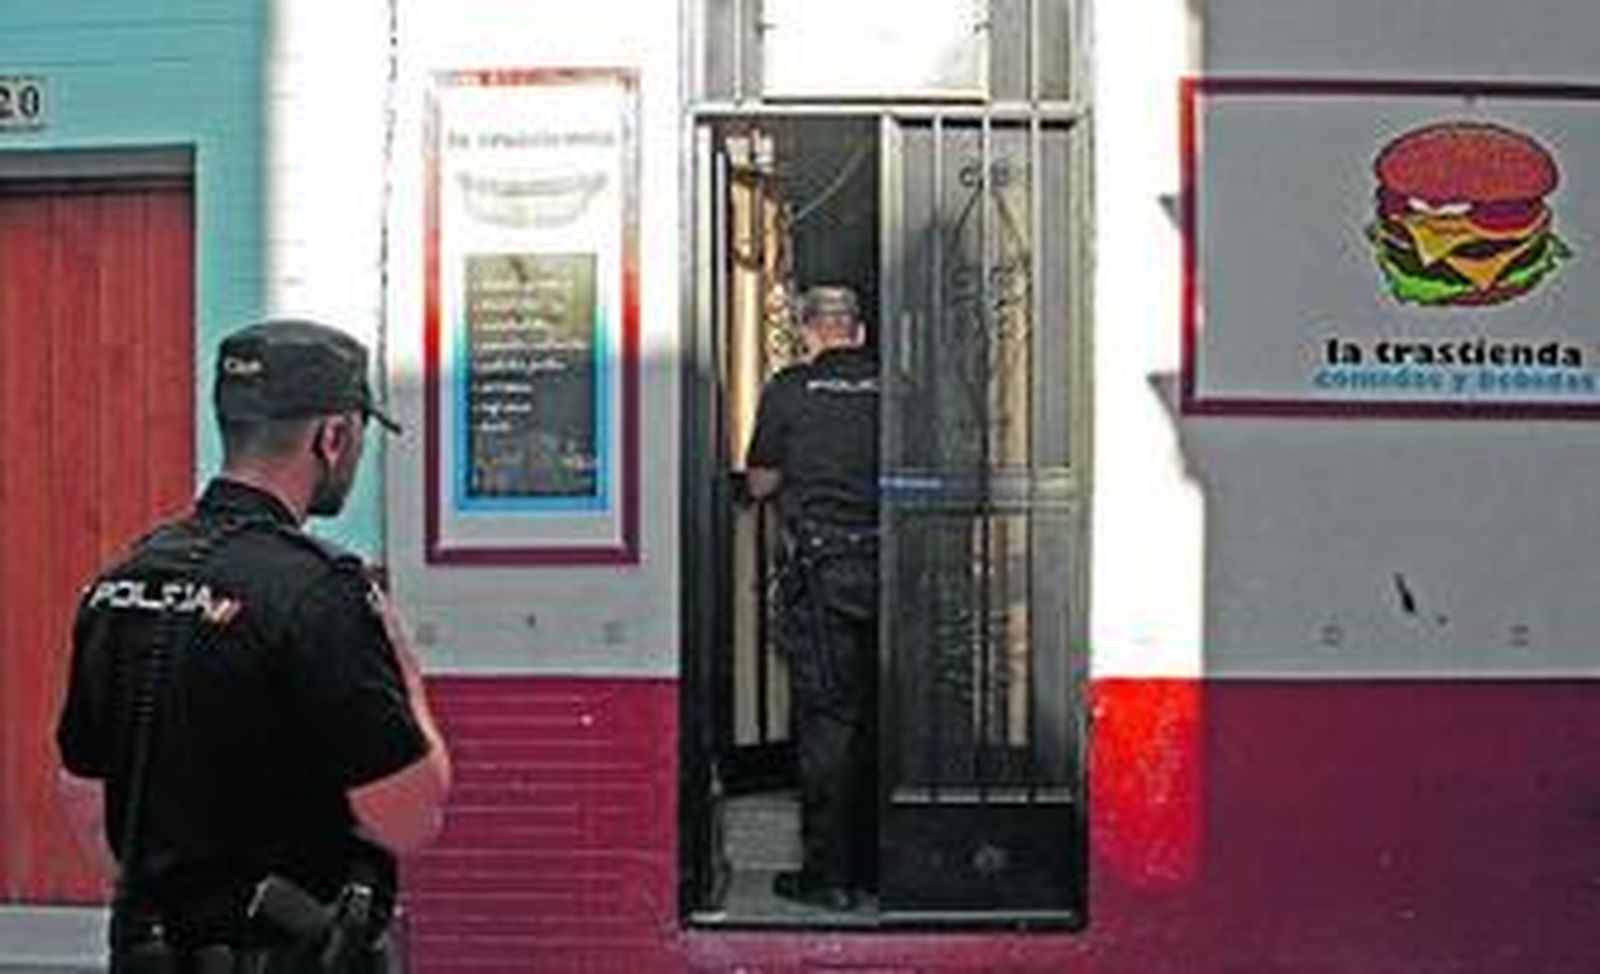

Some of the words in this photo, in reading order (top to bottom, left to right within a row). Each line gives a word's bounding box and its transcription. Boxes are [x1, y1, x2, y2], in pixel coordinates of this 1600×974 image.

[0, 85, 40, 119] 20
[1326, 339, 1362, 365] la
[1376, 339, 1581, 368] trastienda
